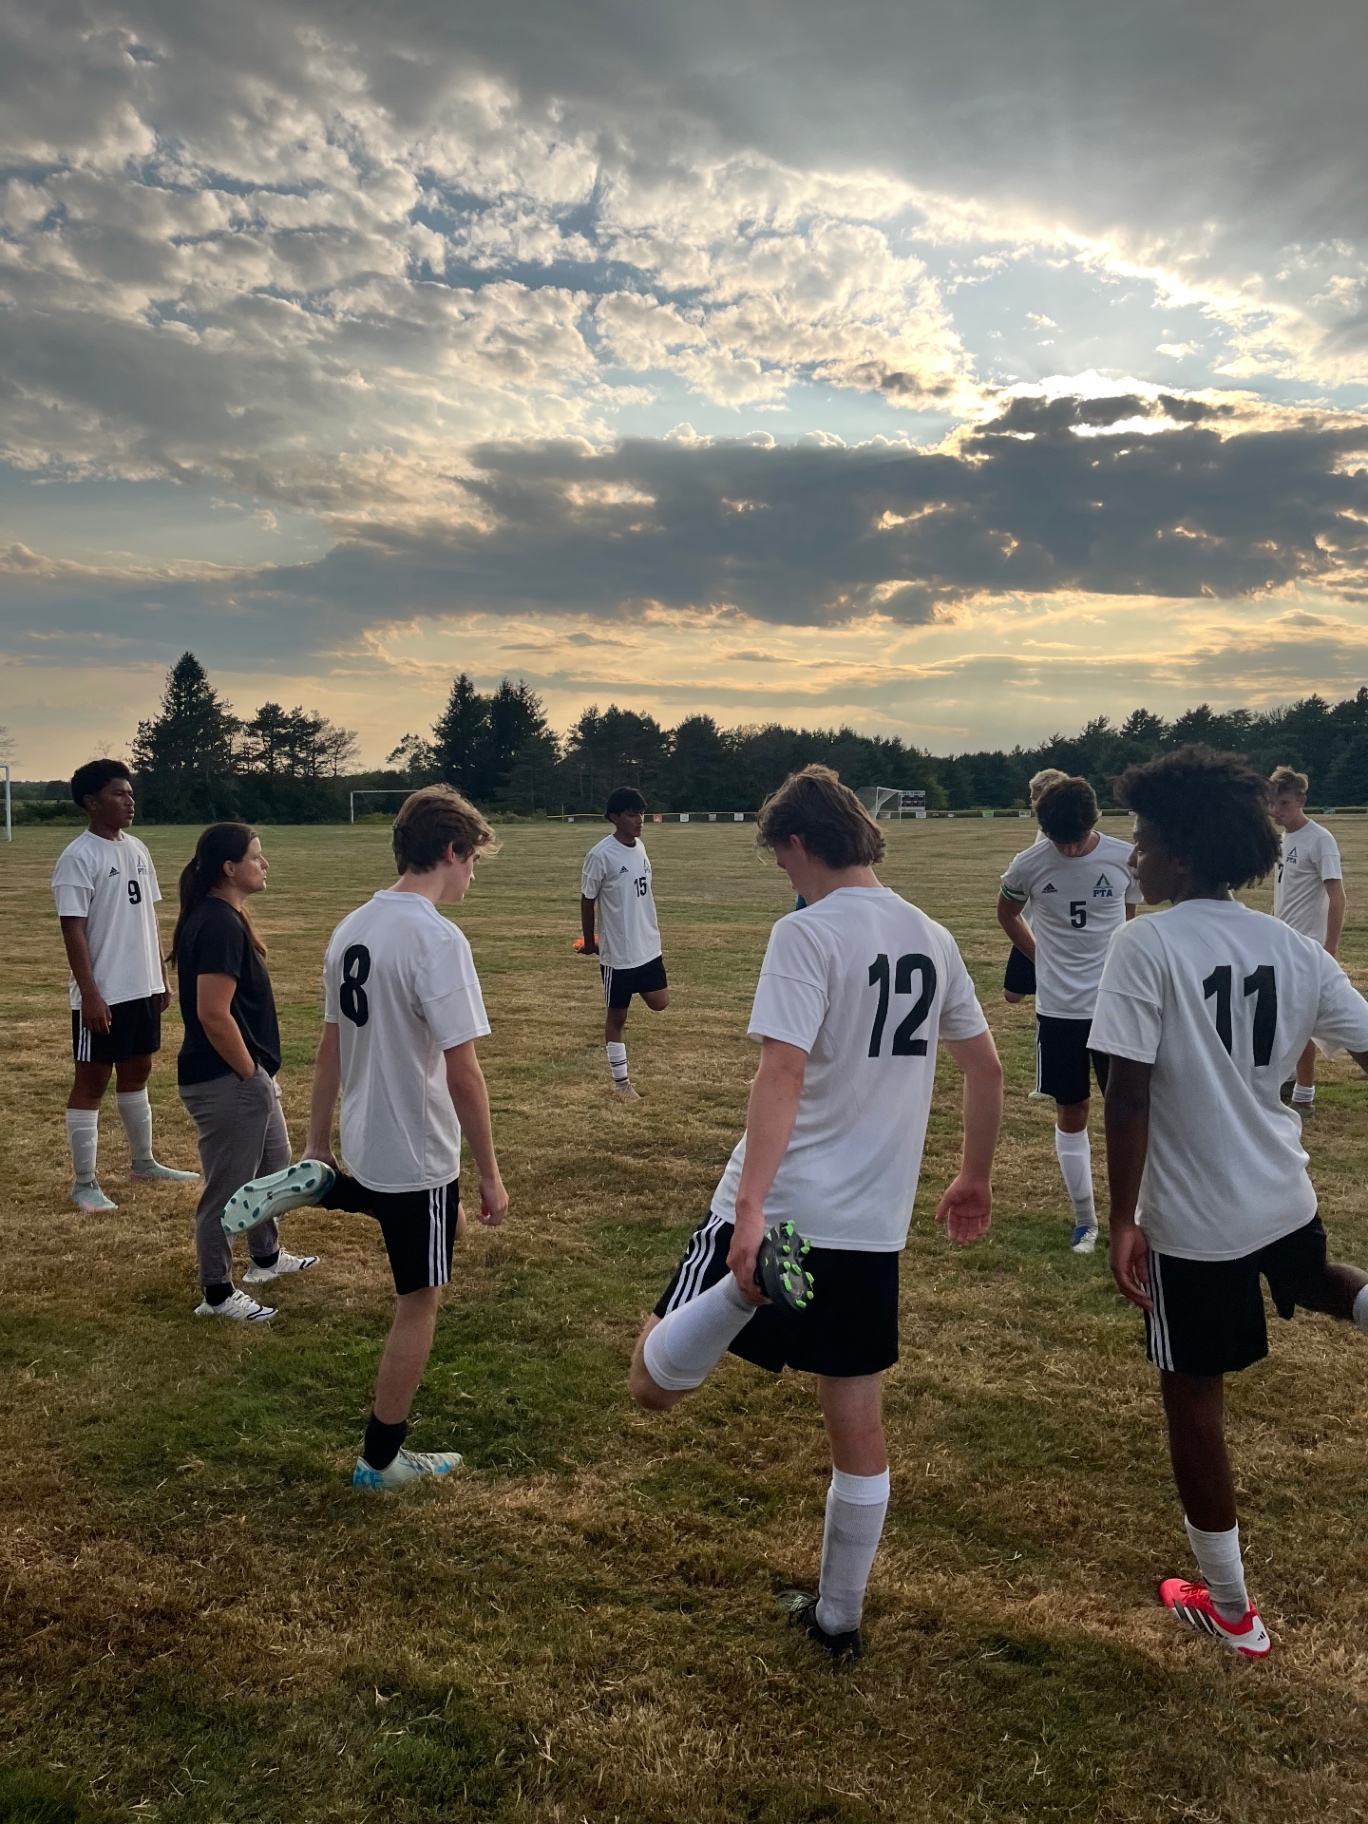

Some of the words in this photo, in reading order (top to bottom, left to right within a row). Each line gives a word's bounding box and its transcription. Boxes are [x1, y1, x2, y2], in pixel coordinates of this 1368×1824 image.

[128, 880, 142, 905] 9
[634, 876, 647, 898] 15
[1093, 889, 1113, 897] PTA
[1070, 901, 1087, 928] 5
[340, 944, 371, 1027] 8
[868, 953, 937, 1058] 12
[1203, 965, 1278, 1067] 11
